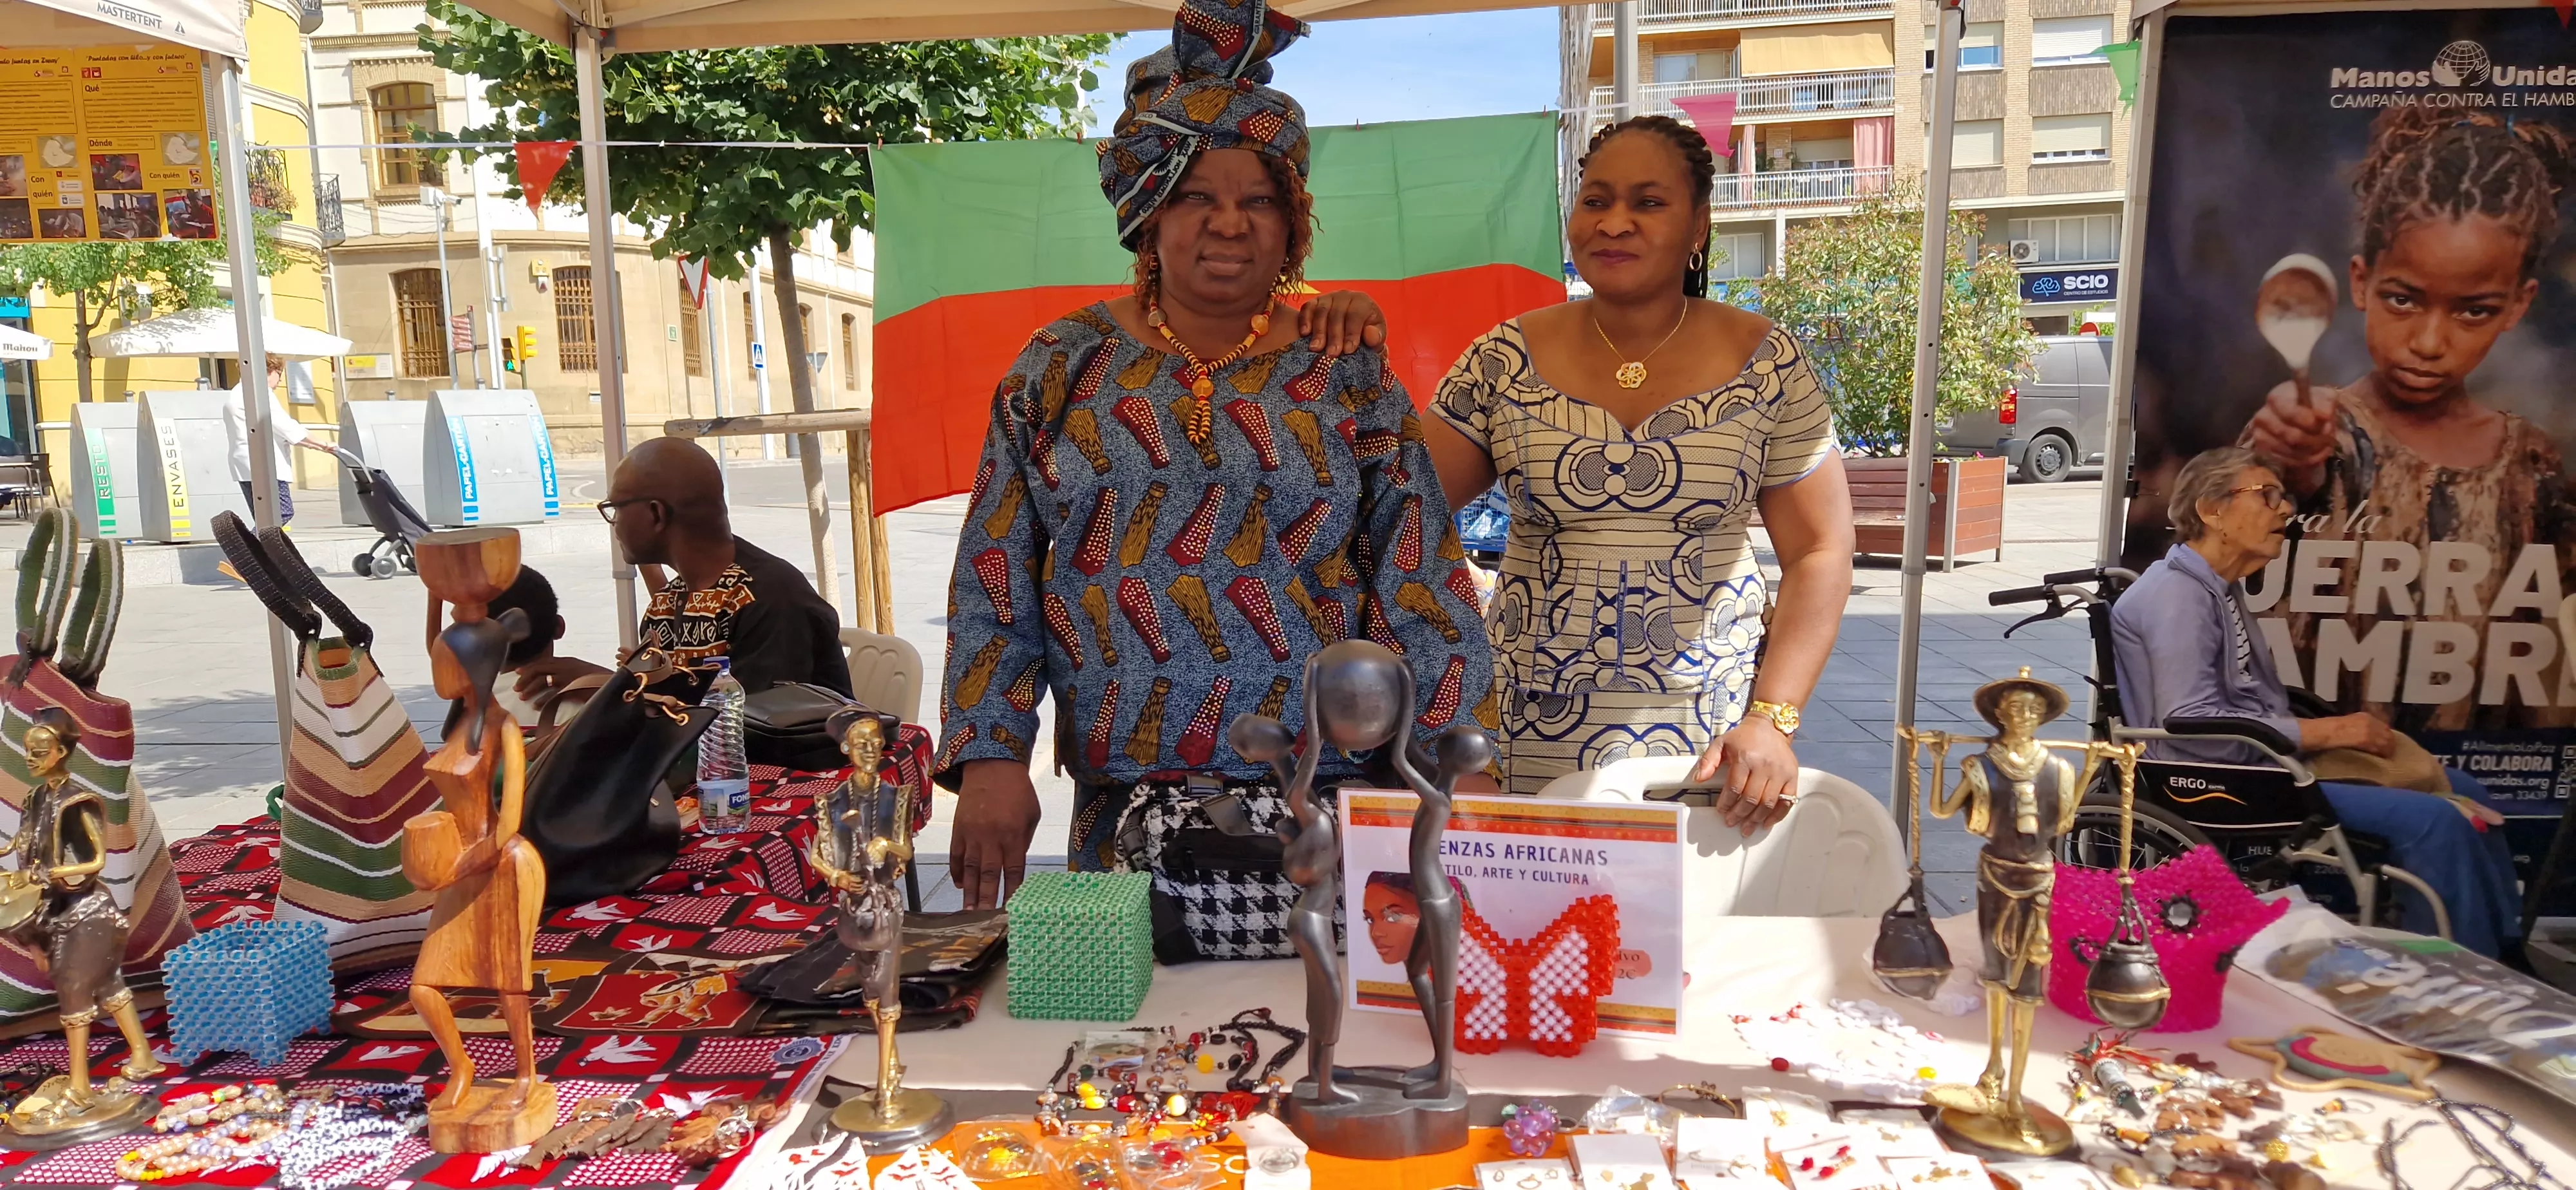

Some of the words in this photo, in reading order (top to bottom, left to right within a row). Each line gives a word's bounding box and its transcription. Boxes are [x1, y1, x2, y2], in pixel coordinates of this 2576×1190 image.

[97, 2, 162, 30] MASTERTENT
[2331, 68, 2430, 88] Manos
[2492, 66, 2576, 87] Unida
[85, 84, 99, 93] Qué
[2331, 90, 2416, 108] CAMPAÑA
[2424, 93, 2496, 108] CONTRA
[2502, 93, 2518, 107] EL
[2524, 93, 2576, 107] HAMB
[162, 172, 180, 180] quién
[2063, 274, 2108, 290] SCIO
[92, 444, 110, 499] RESTO
[162, 426, 184, 507] ENVASES
[2286, 513, 2331, 533] ra
[2343, 499, 2382, 533] la
[2240, 540, 2563, 618] UERRA
[2470, 755, 2553, 771] COLABORA
[2170, 777, 2206, 789] ERGO
[2476, 774, 2550, 789] sunidas.org
[732, 793, 750, 804] FONT
[1439, 840, 1495, 858] ENZAS
[1504, 844, 1608, 866] AFRICANAS
[1444, 865, 1477, 878] TILO,
[1482, 867, 1513, 880] ARTE
[1519, 869, 1527, 880] Y
[1533, 871, 1589, 885] CULTURA
[1619, 950, 1640, 961] ivo
